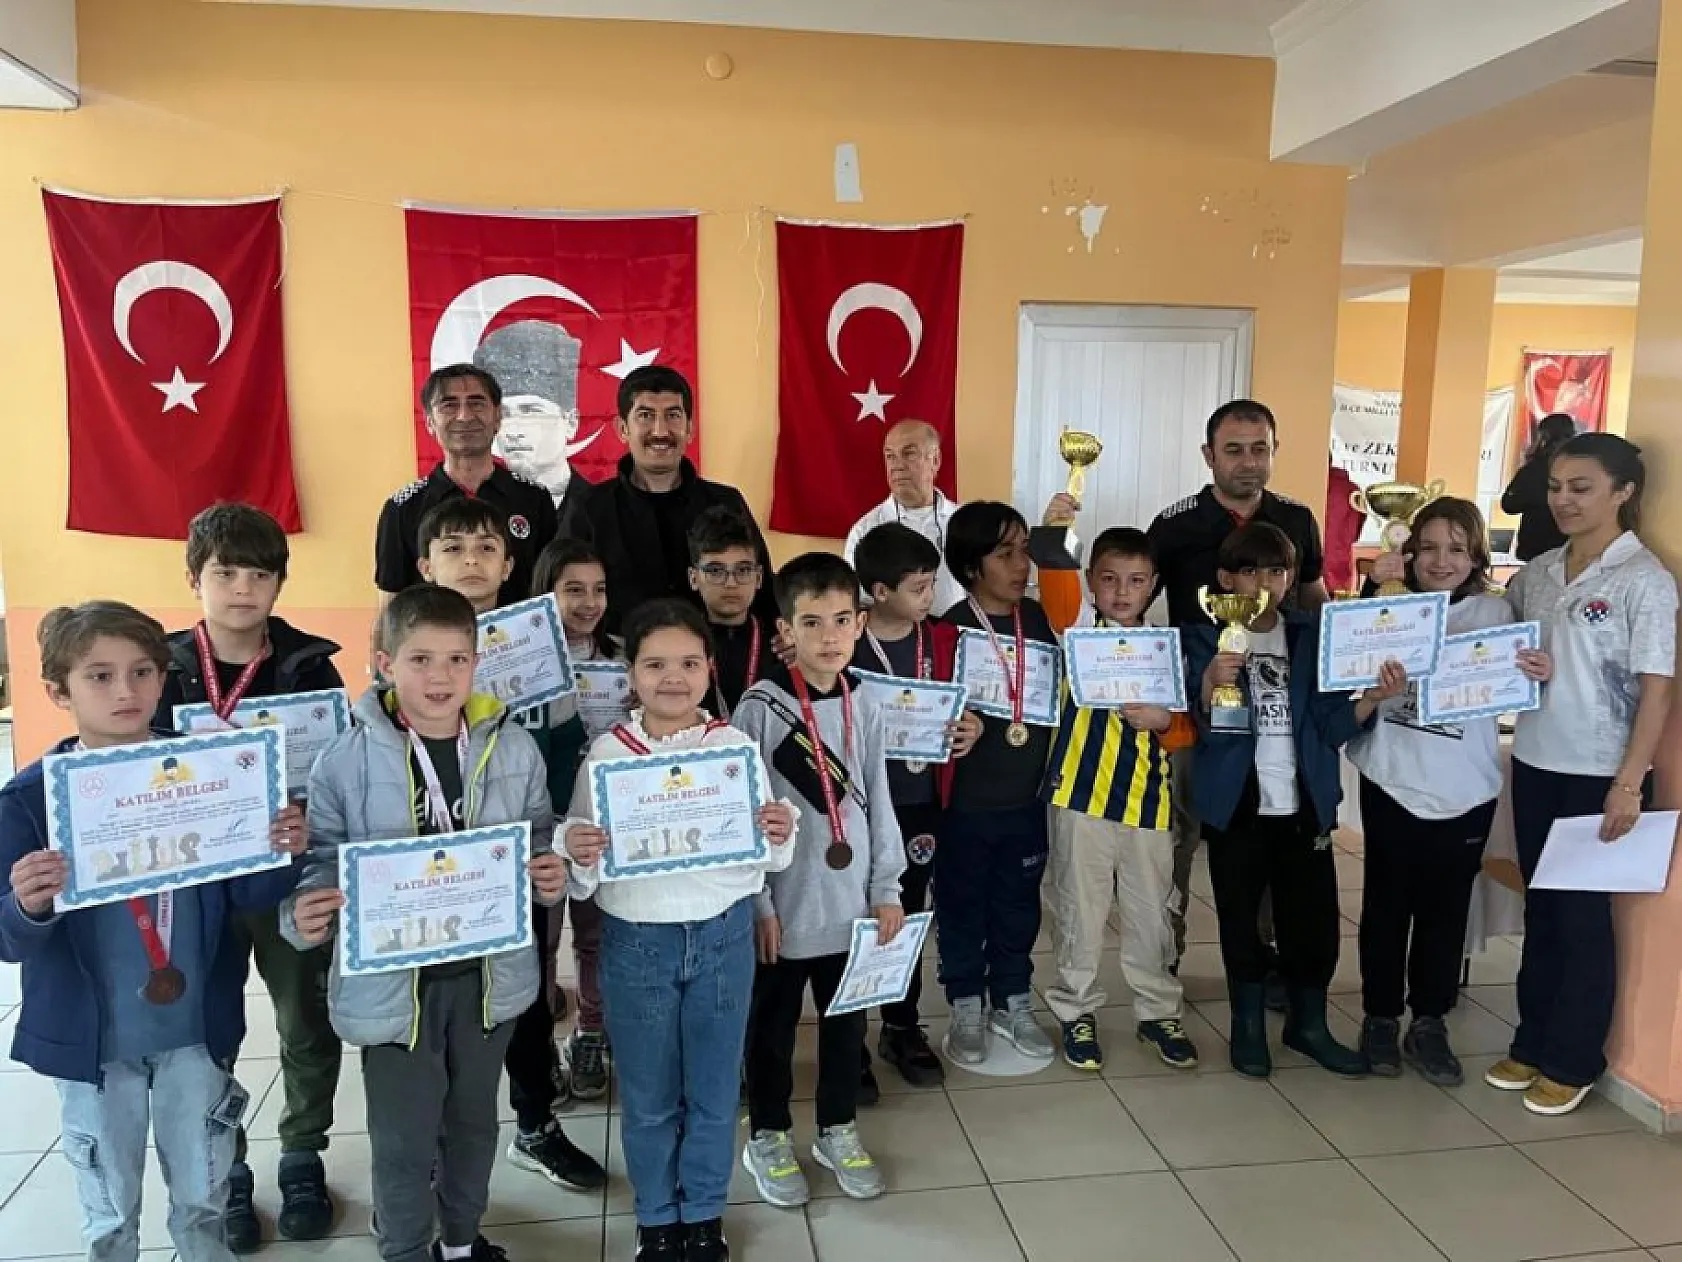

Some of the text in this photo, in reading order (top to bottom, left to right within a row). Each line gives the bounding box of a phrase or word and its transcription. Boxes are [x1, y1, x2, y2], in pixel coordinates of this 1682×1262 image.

[1363, 441, 1396, 456] ZEK
[1342, 459, 1394, 475] TURNU
[115, 777, 230, 808] KATILIM BELGESİ
